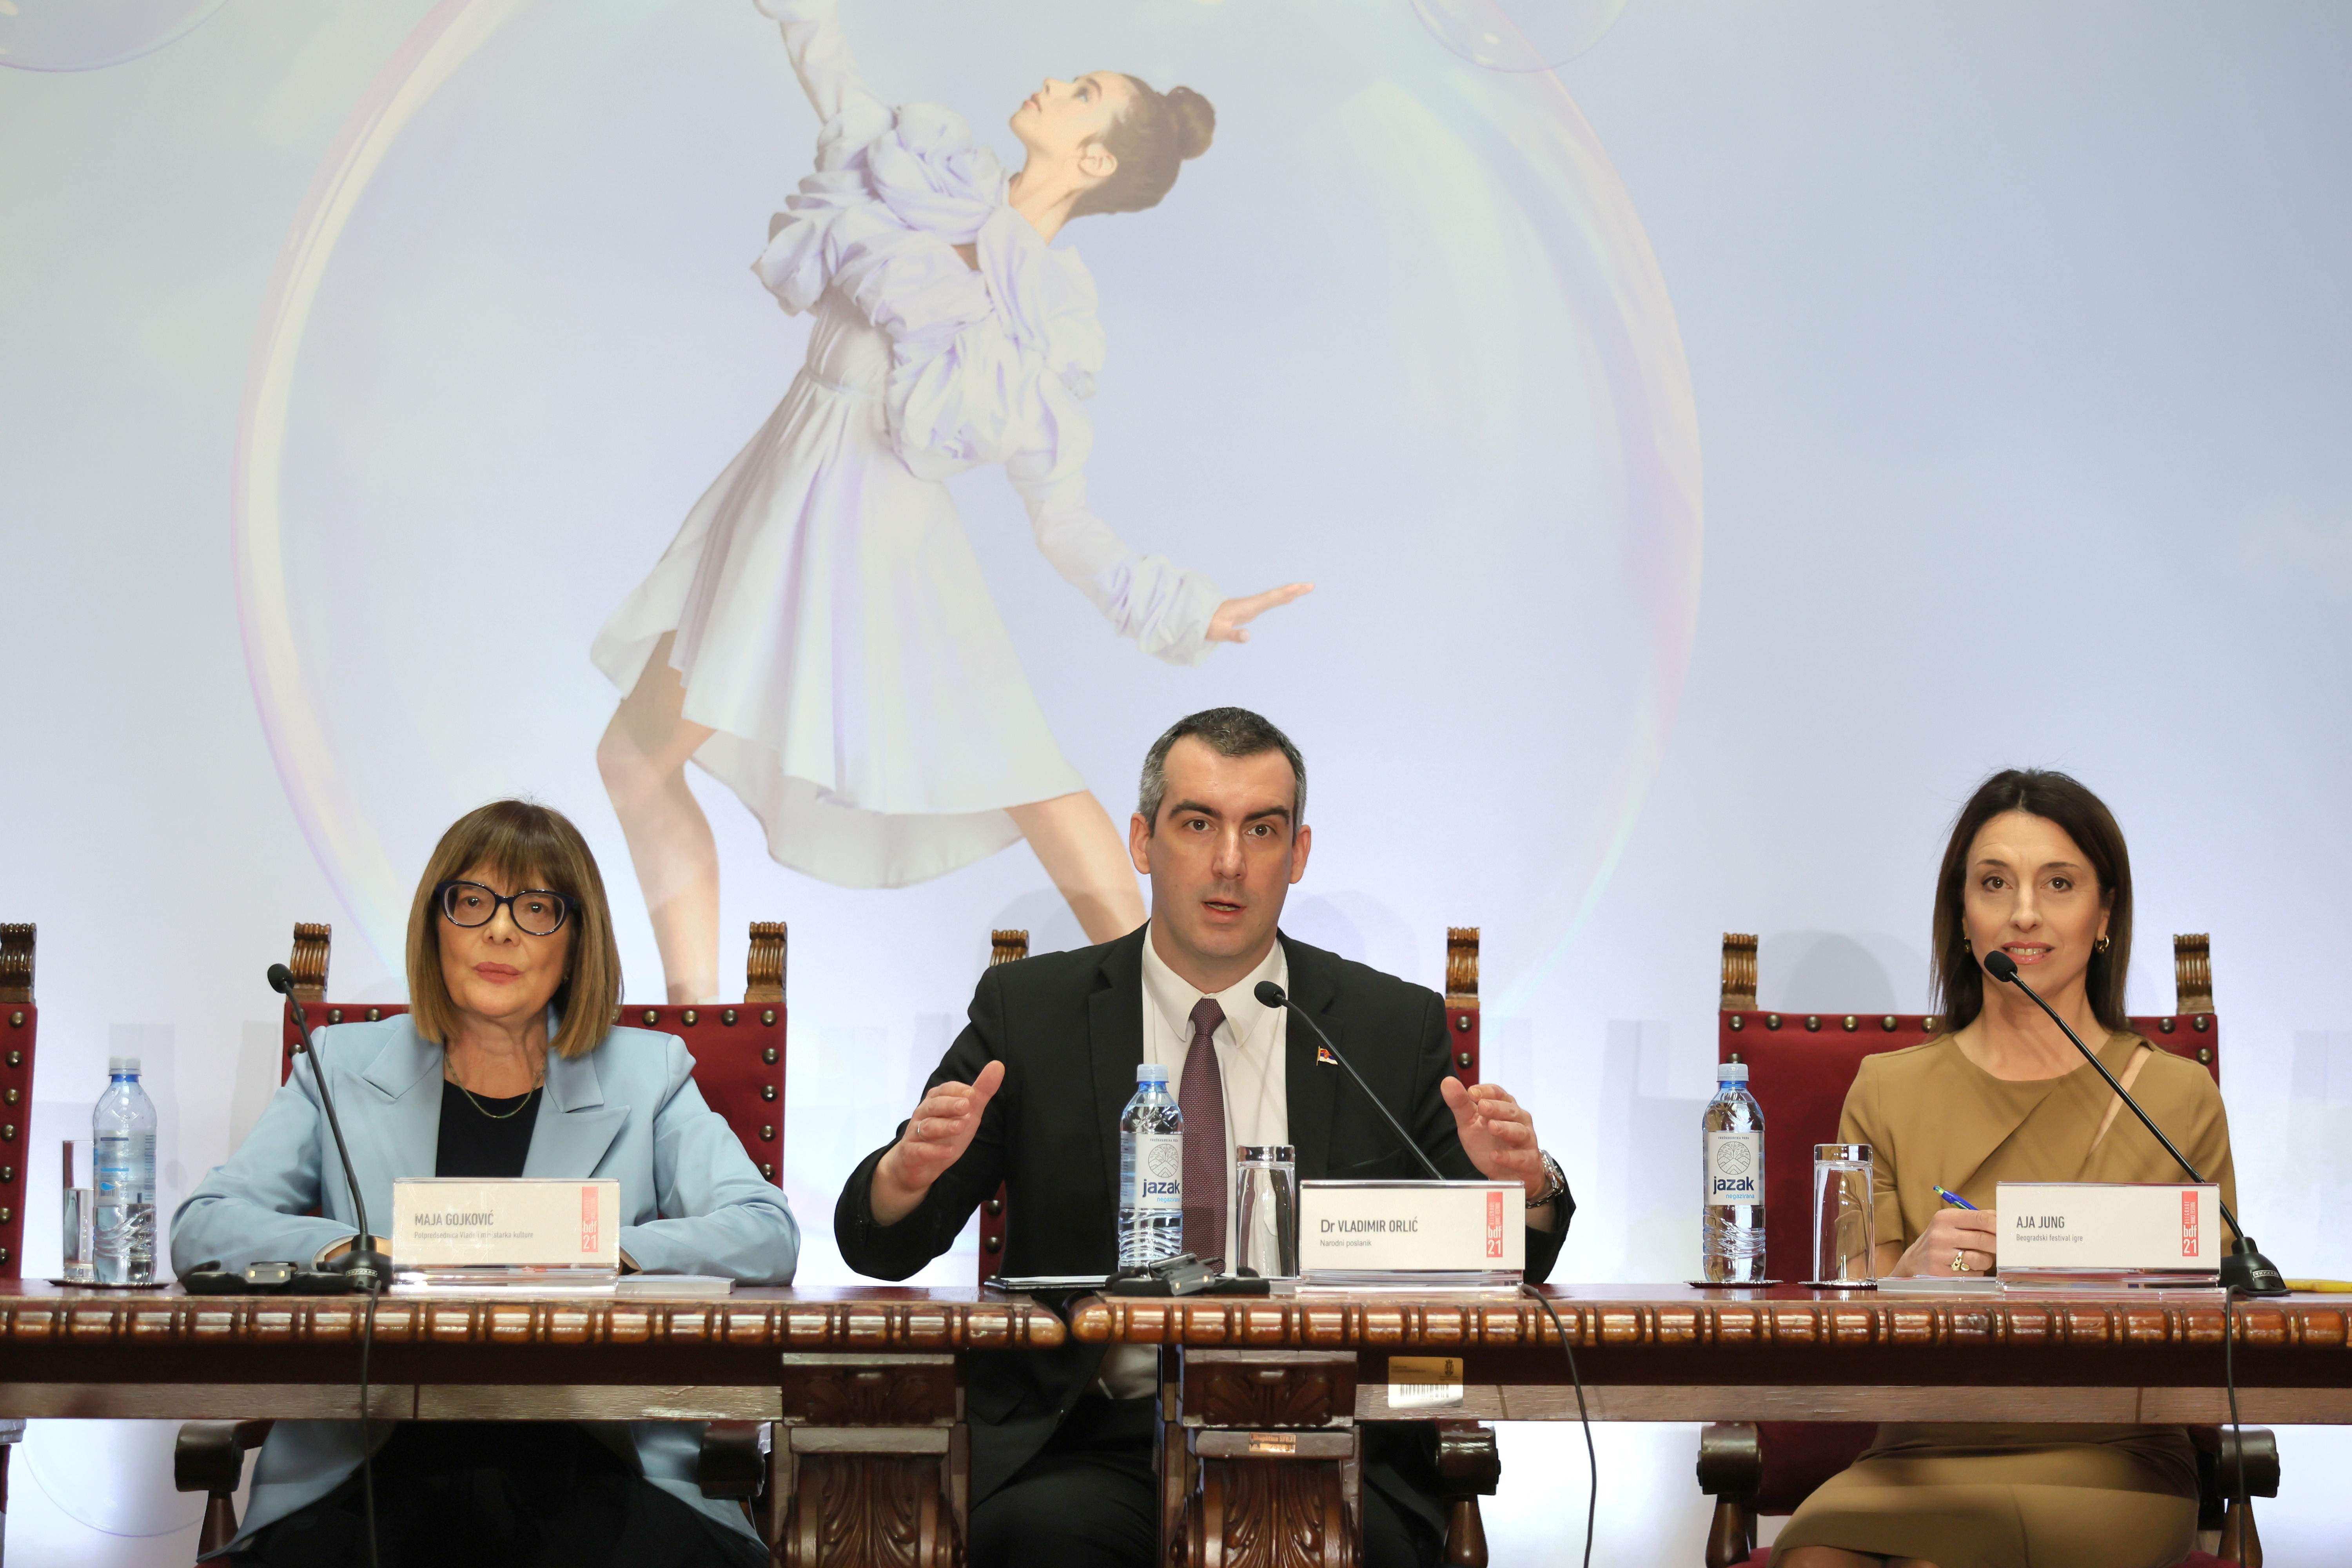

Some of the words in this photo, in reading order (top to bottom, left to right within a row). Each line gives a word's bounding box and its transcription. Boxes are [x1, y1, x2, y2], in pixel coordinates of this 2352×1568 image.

[1142, 1179, 1180, 1198] jazak
[1713, 1176, 1755, 1194] jazak
[415, 1214, 443, 1225] MAJA
[446, 1210, 494, 1225] GOJKOVIĆ
[1321, 1220, 1335, 1232] Dr
[1338, 1220, 1386, 1232] VLADIMIR
[1389, 1216, 1417, 1232] ORLIĆ
[2016, 1216, 2035, 1228] AJA
[2038, 1216, 2065, 1228] JUNG
[583, 1220, 597, 1233] bdf
[1488, 1225, 1502, 1238] bdf
[2183, 1225, 2197, 1237] bdf
[415, 1231, 458, 1240] Potpredsednica
[583, 1234, 597, 1249] 21
[2016, 1234, 2047, 1242] Beogradski
[2072, 1234, 2083, 1243] igre
[1488, 1240, 1501, 1254] 21
[2183, 1239, 2196, 1254] 21
